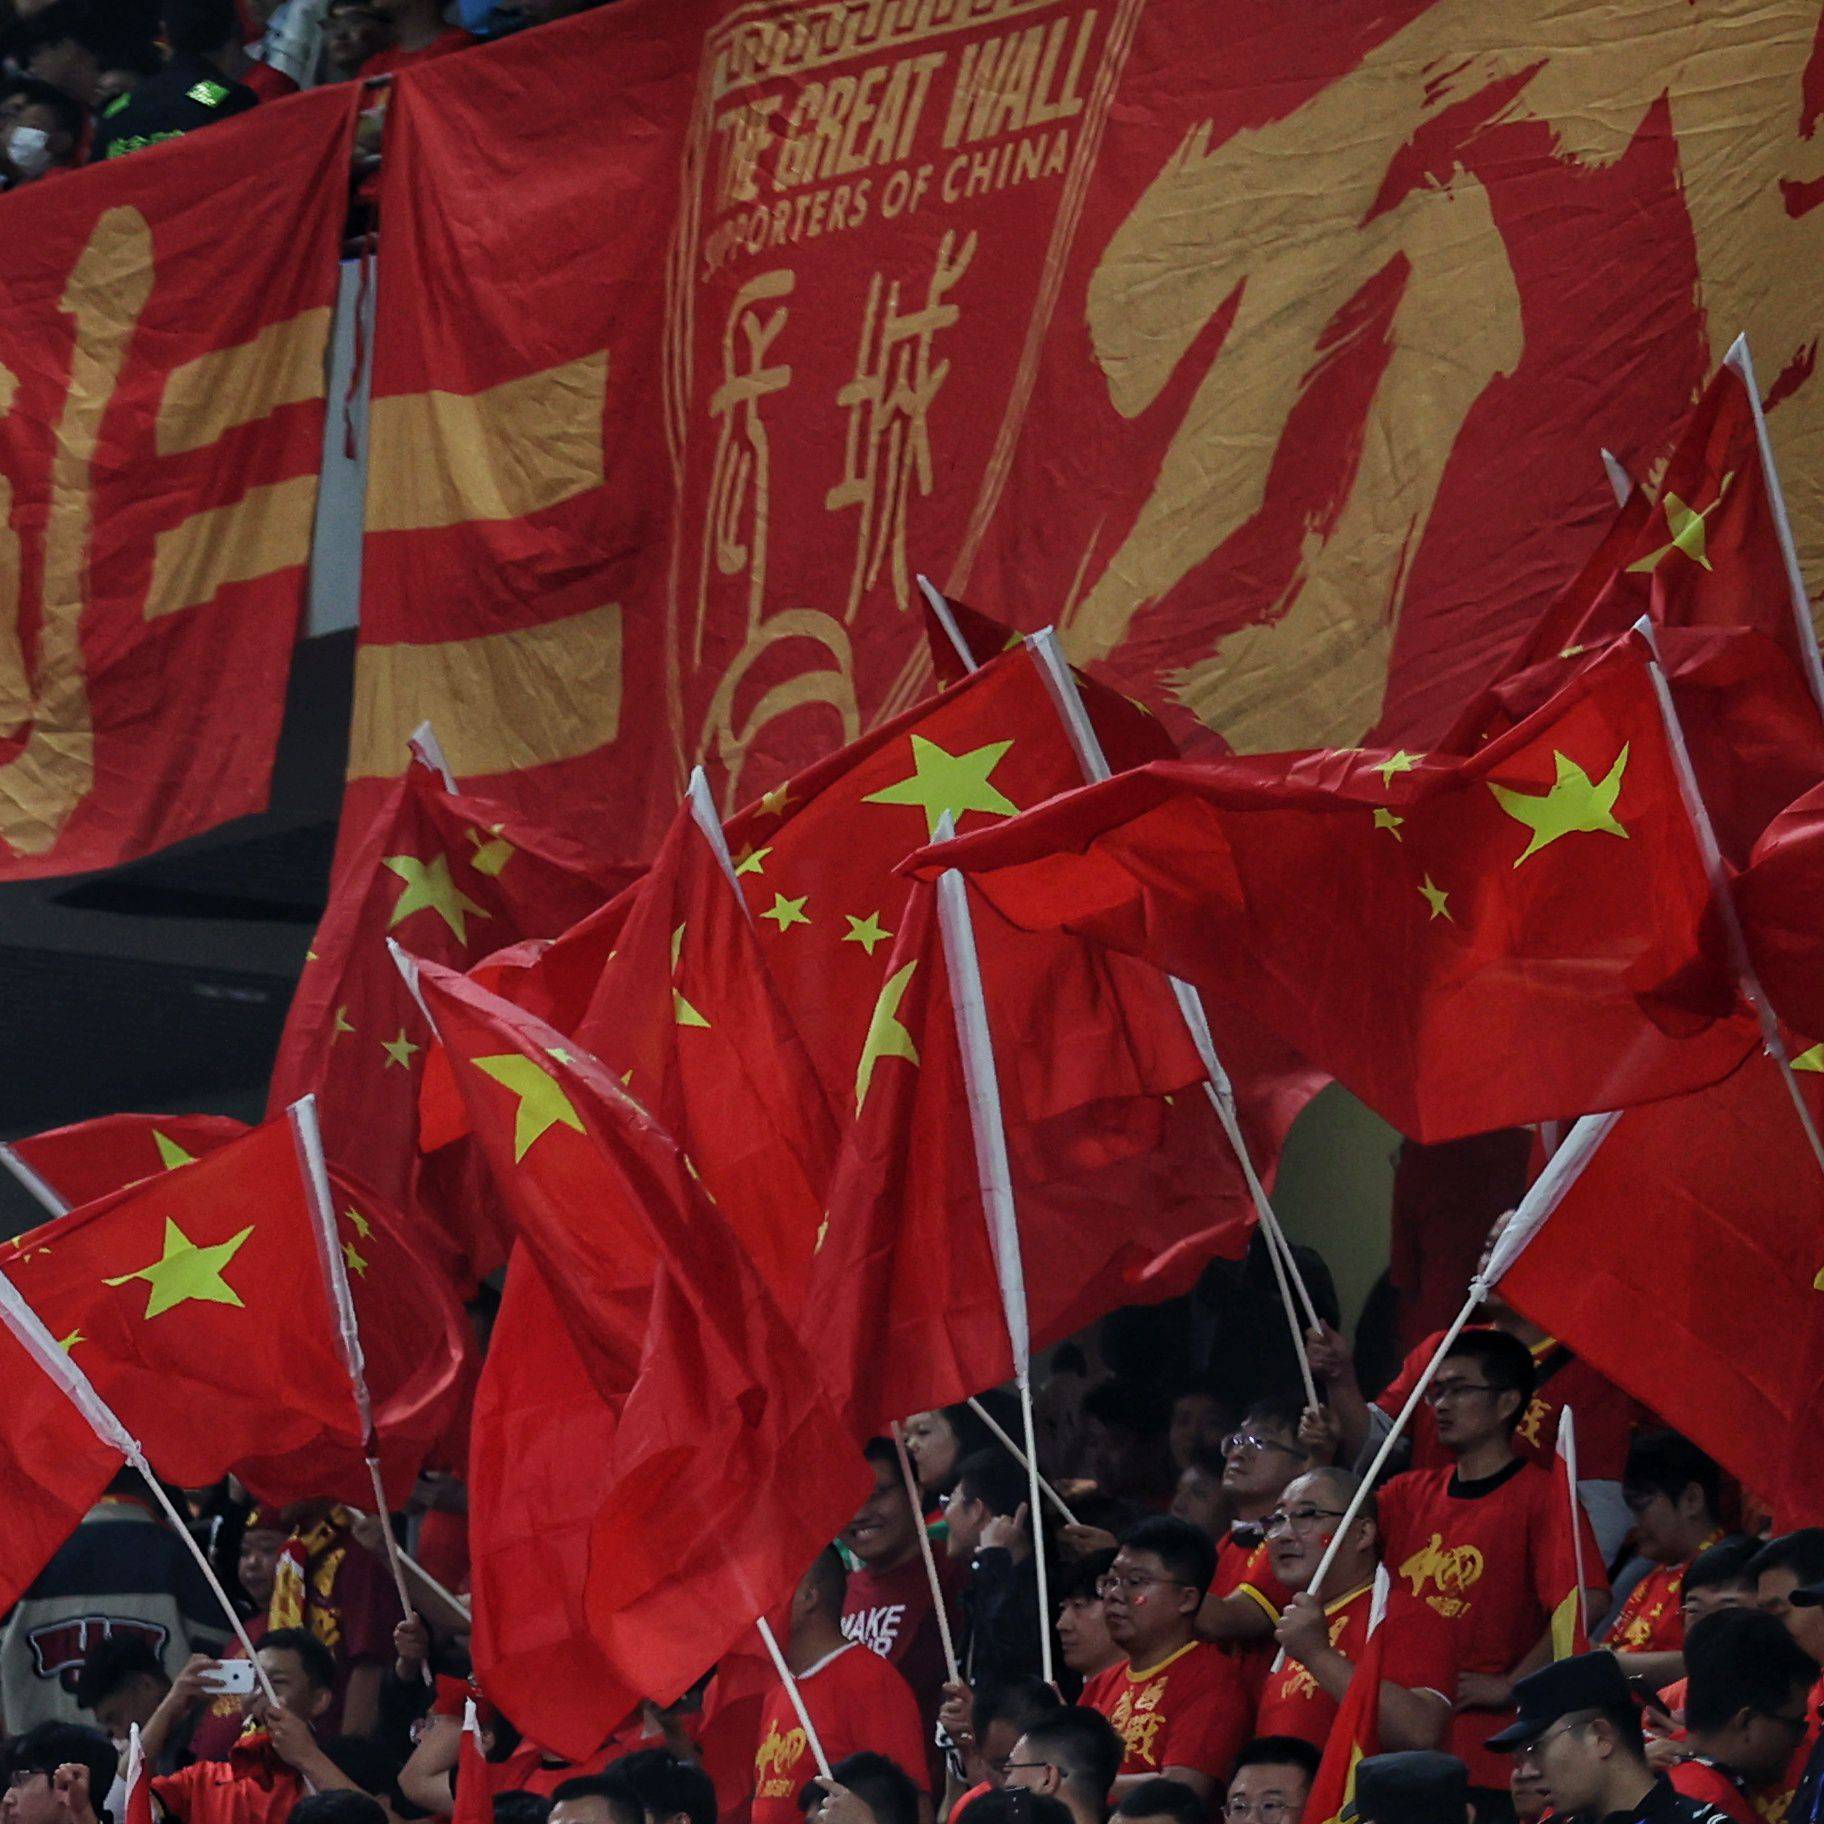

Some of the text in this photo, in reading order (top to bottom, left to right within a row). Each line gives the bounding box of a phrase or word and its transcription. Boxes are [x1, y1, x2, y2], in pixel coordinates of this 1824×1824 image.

[774, 52, 946, 192] GREAT
[943, 9, 1097, 149] WALL
[882, 164, 933, 218] OF
[943, 129, 1067, 203] CHINA
